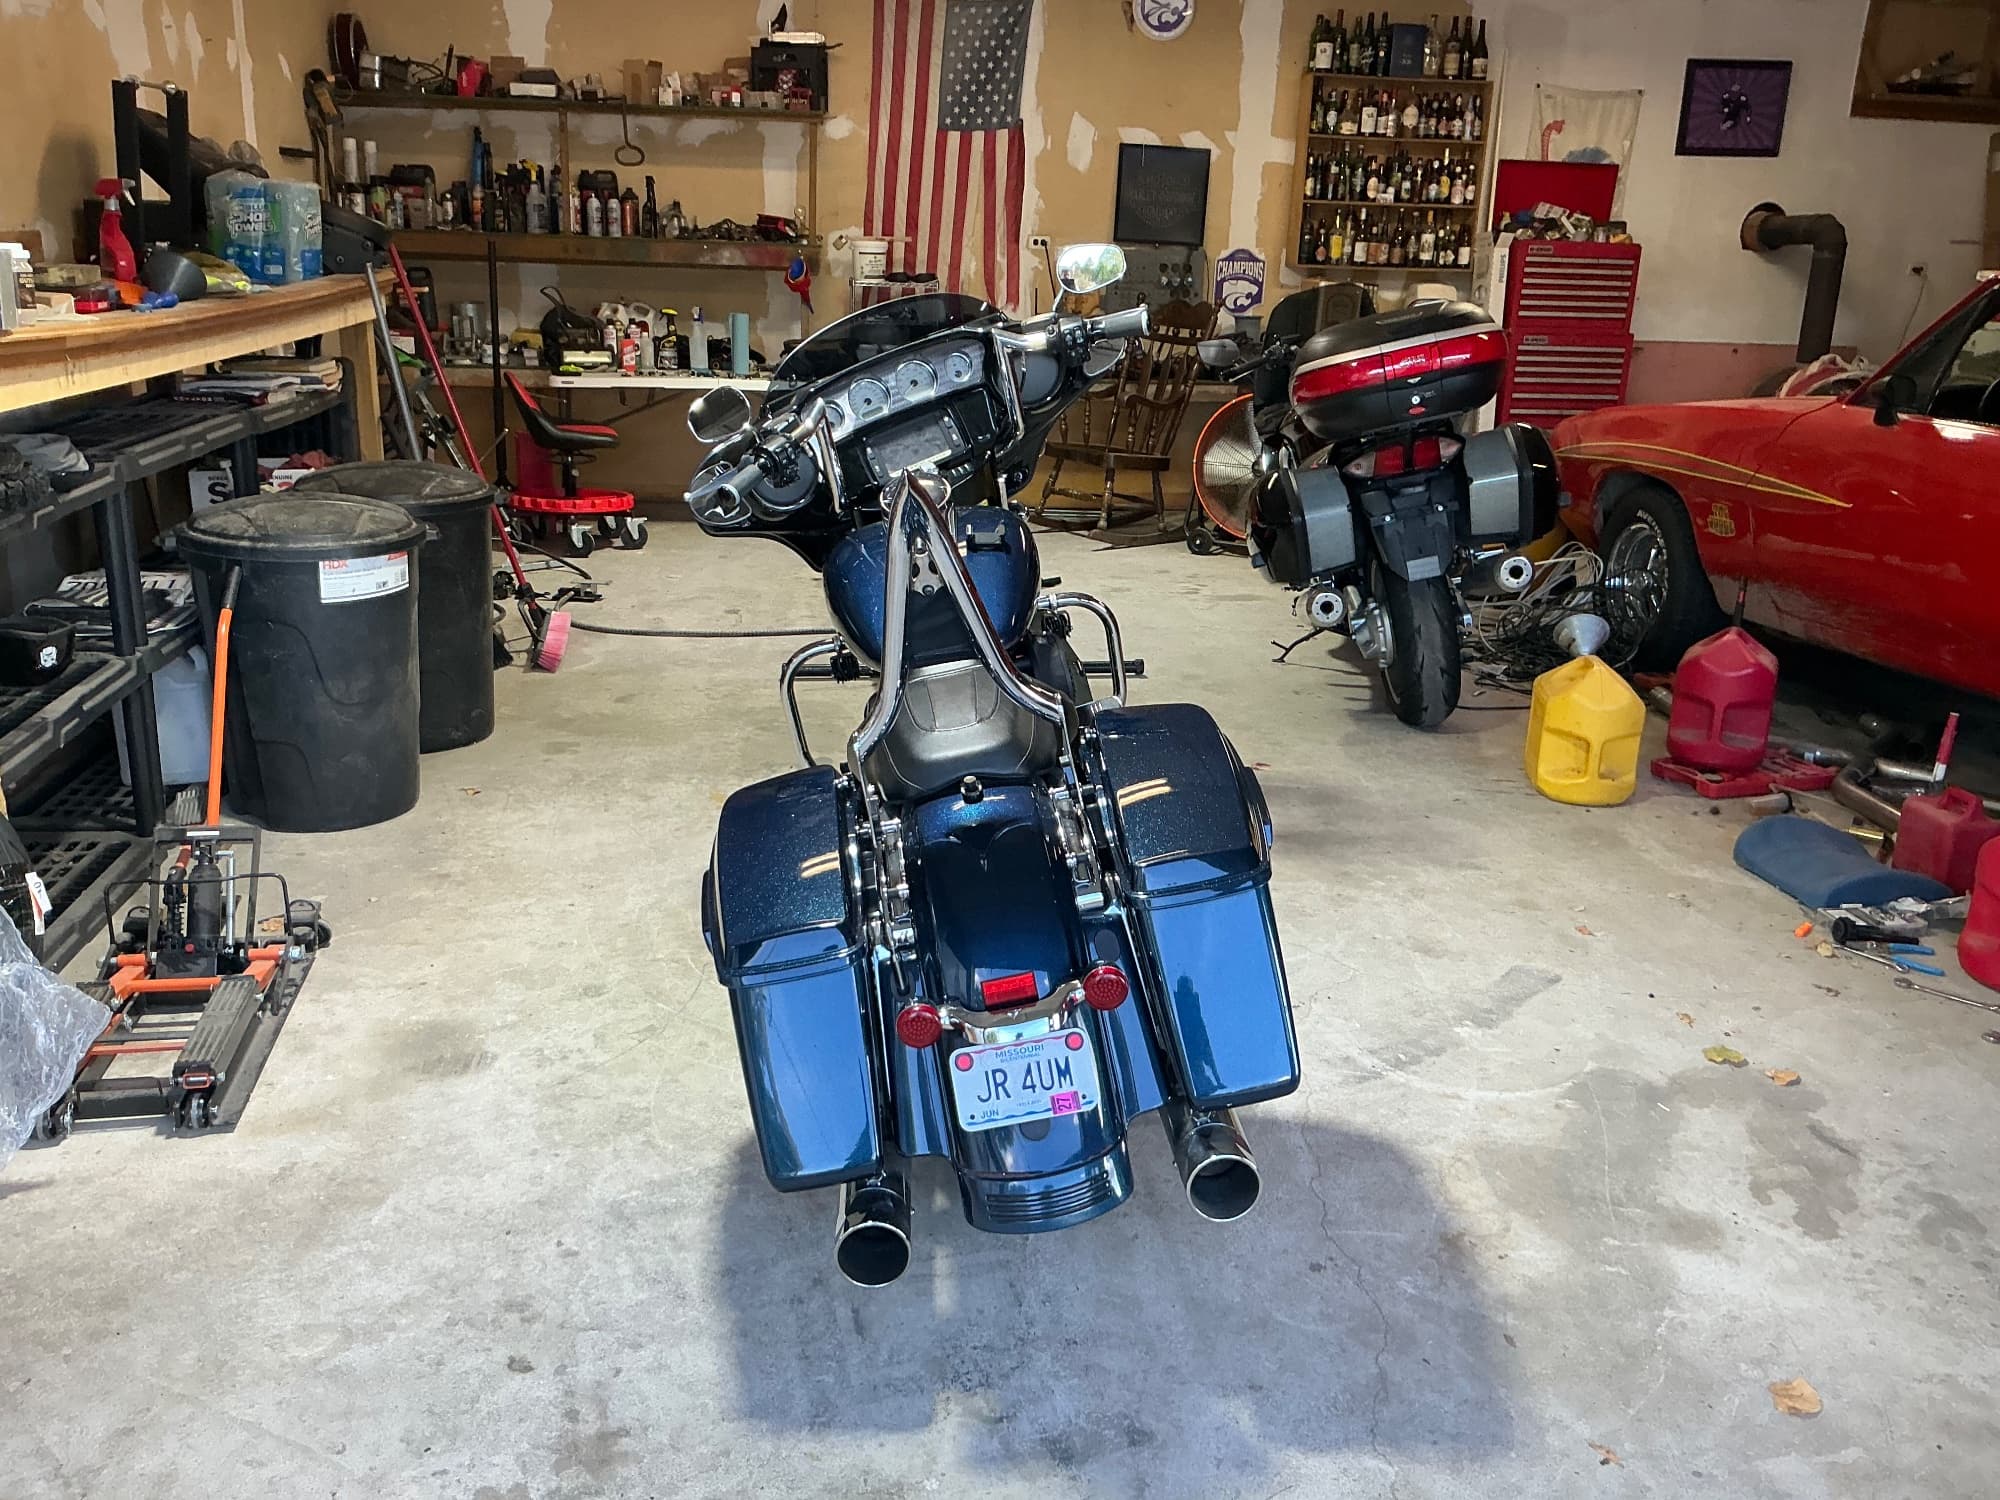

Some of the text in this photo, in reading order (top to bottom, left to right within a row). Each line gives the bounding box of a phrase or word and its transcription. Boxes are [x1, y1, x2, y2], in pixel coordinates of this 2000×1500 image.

[1217, 261, 1264, 282] CHAMPIONS
[322, 559, 348, 570] HDX
[995, 1043, 1044, 1058] MISSOURI
[977, 1055, 1074, 1103] JR 4UM
[1055, 1097, 1072, 1112] 27
[980, 1108, 999, 1120] JUN
